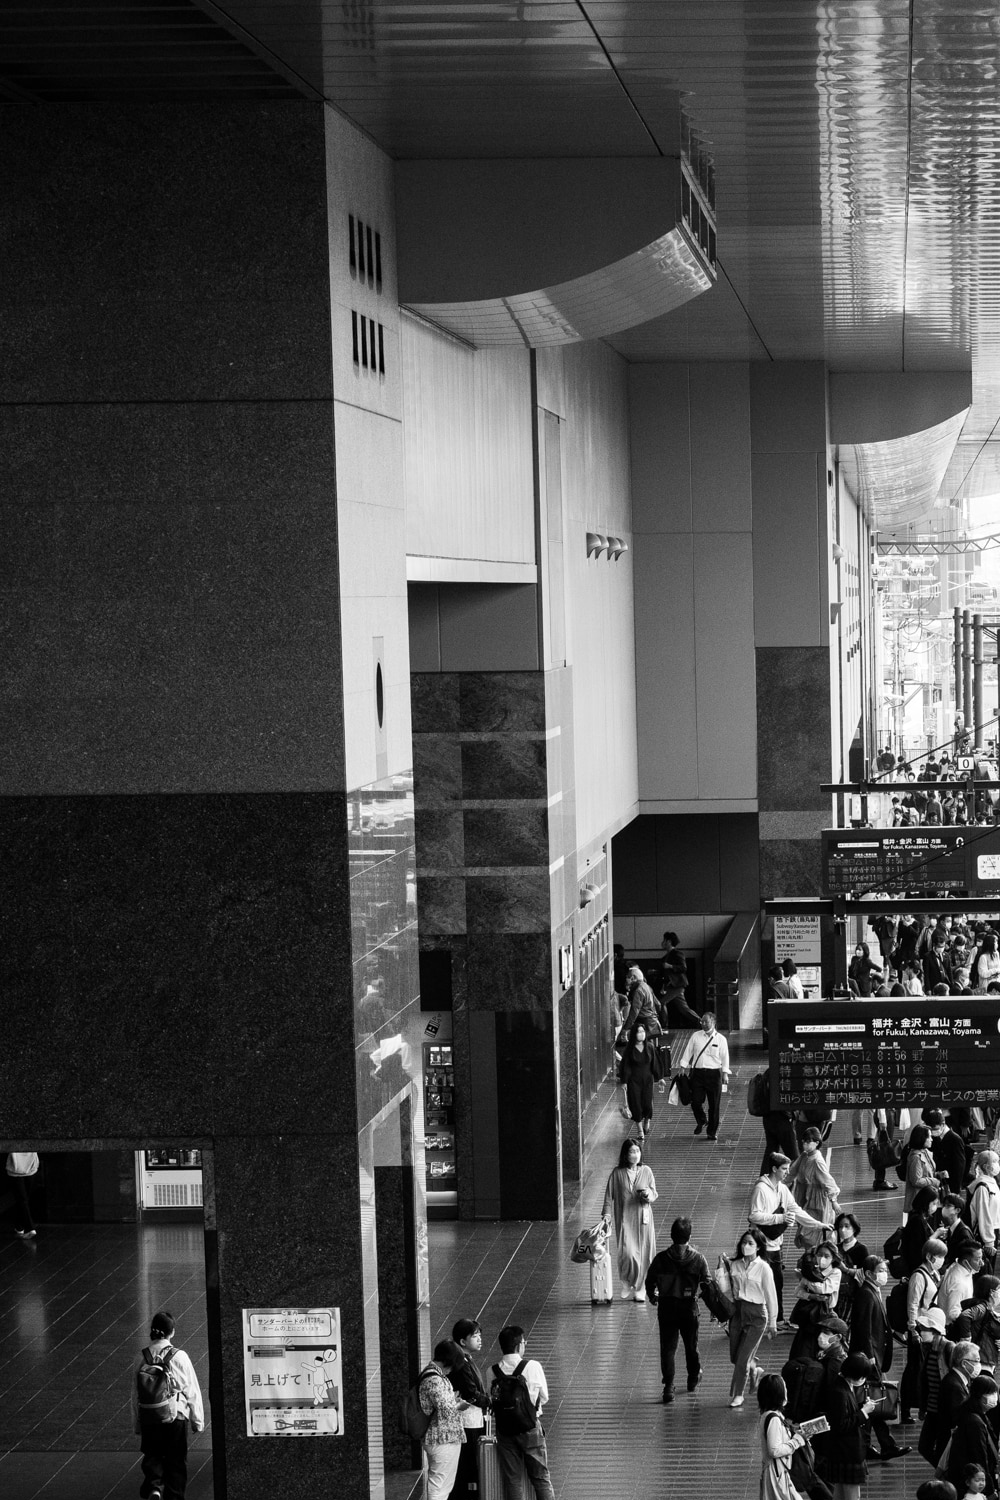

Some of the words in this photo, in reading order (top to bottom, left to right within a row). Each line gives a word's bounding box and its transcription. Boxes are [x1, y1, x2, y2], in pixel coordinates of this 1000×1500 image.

[962, 759, 970, 768] 0
[872, 1018, 950, 1028] 福井・金沢・富山
[954, 1018, 971, 1027] 方面
[873, 1028, 884, 1036] for
[886, 1028, 908, 1036] Fukui,
[910, 1028, 951, 1036] Kanazawa,
[952, 1028, 981, 1036] Toyama
[877, 1050, 907, 1061] 8:56
[877, 1064, 906, 1075] 9:11
[913, 1063, 948, 1075] 金沢
[877, 1078, 907, 1088] 9:42
[913, 1077, 948, 1089] 金沢
[250, 1373, 312, 1386] 見上げて！
